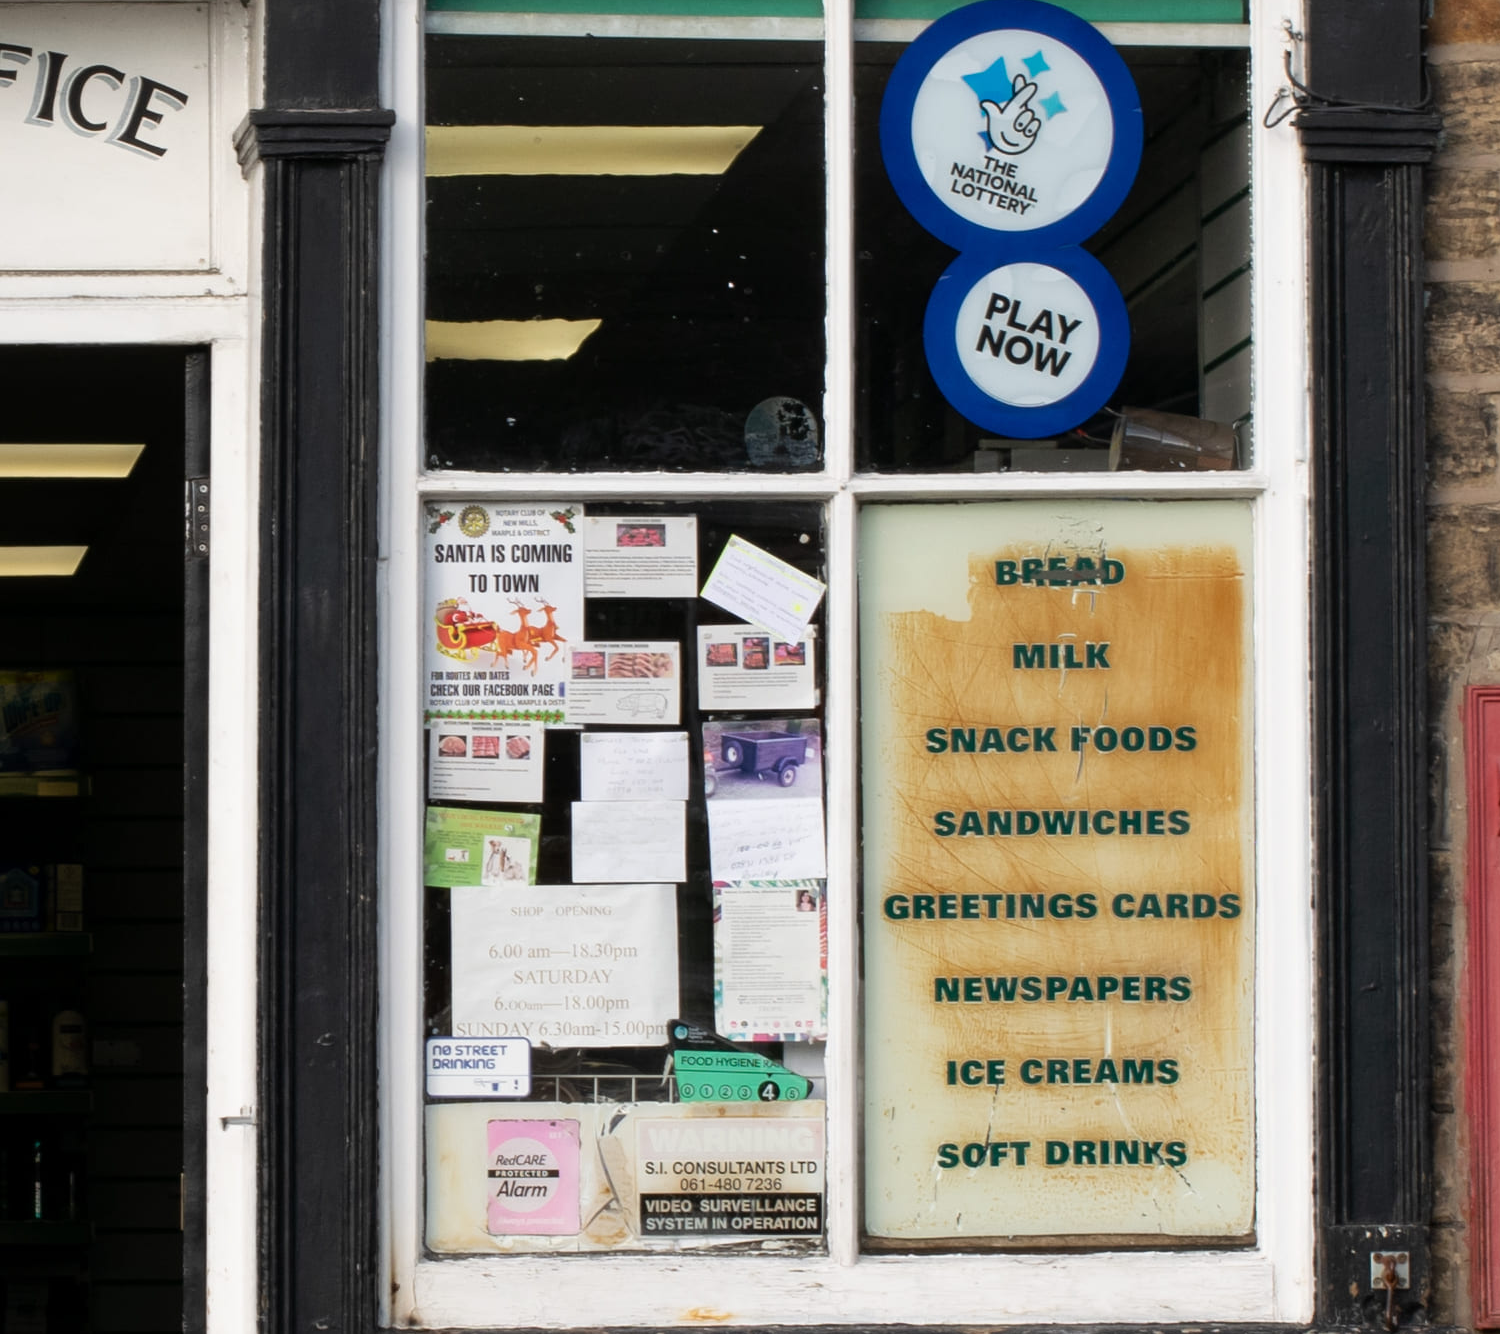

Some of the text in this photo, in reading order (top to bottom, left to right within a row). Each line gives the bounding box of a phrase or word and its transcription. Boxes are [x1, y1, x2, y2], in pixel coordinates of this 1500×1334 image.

[983, 155, 1019, 180] THE
[949, 161, 1039, 204] NATIONAL
[949, 178, 1032, 216] LOTTERY
[984, 292, 1082, 345] PLAY
[975, 325, 1072, 378] NOW
[520, 509, 536, 517] CLUB
[537, 509, 546, 517] OF
[523, 529, 551, 537] DISTRICT
[434, 543, 573, 564] SANTA IS COMING
[995, 557, 1126, 587] BREAD
[468, 574, 540, 593] TO TOWN
[1013, 643, 1112, 669] MILK
[430, 671, 511, 681] FOR ROUTES AND DATES
[430, 684, 555, 697] CHECK OUR FACEBOOK PAGE
[925, 725, 1197, 753] SNACK FOODS
[933, 809, 1191, 836] SANDWICHES
[511, 905, 612, 917] SHOP OPENING
[884, 893, 1242, 920] GREETINGS CARDS
[488, 944, 523, 958] 6.00
[513, 969, 614, 985] SATURDAY
[934, 976, 1192, 1002] NEWSPAPERS
[456, 1022, 534, 1038] SUNDAY
[454, 1044, 508, 1056] STREET
[432, 1058, 496, 1070] DRINKING
[681, 1056, 761, 1068] FOOD HYGIENE
[946, 1059, 1180, 1085] ICE CREAMS
[761, 1083, 776, 1099] 4
[648, 1127, 815, 1153] WARNING
[496, 1154, 548, 1166] RedCARE
[937, 1141, 1187, 1168] SOFT DRINKS
[645, 1160, 818, 1175] S.I. CONSULTANTS LTD
[496, 1180, 548, 1198] Alarm
[680, 1177, 783, 1191] 061-480 7236
[645, 1199, 817, 1213] VIDEO SURVEILLANCE
[645, 1216, 818, 1231] SYSTEM IN OPERATION
